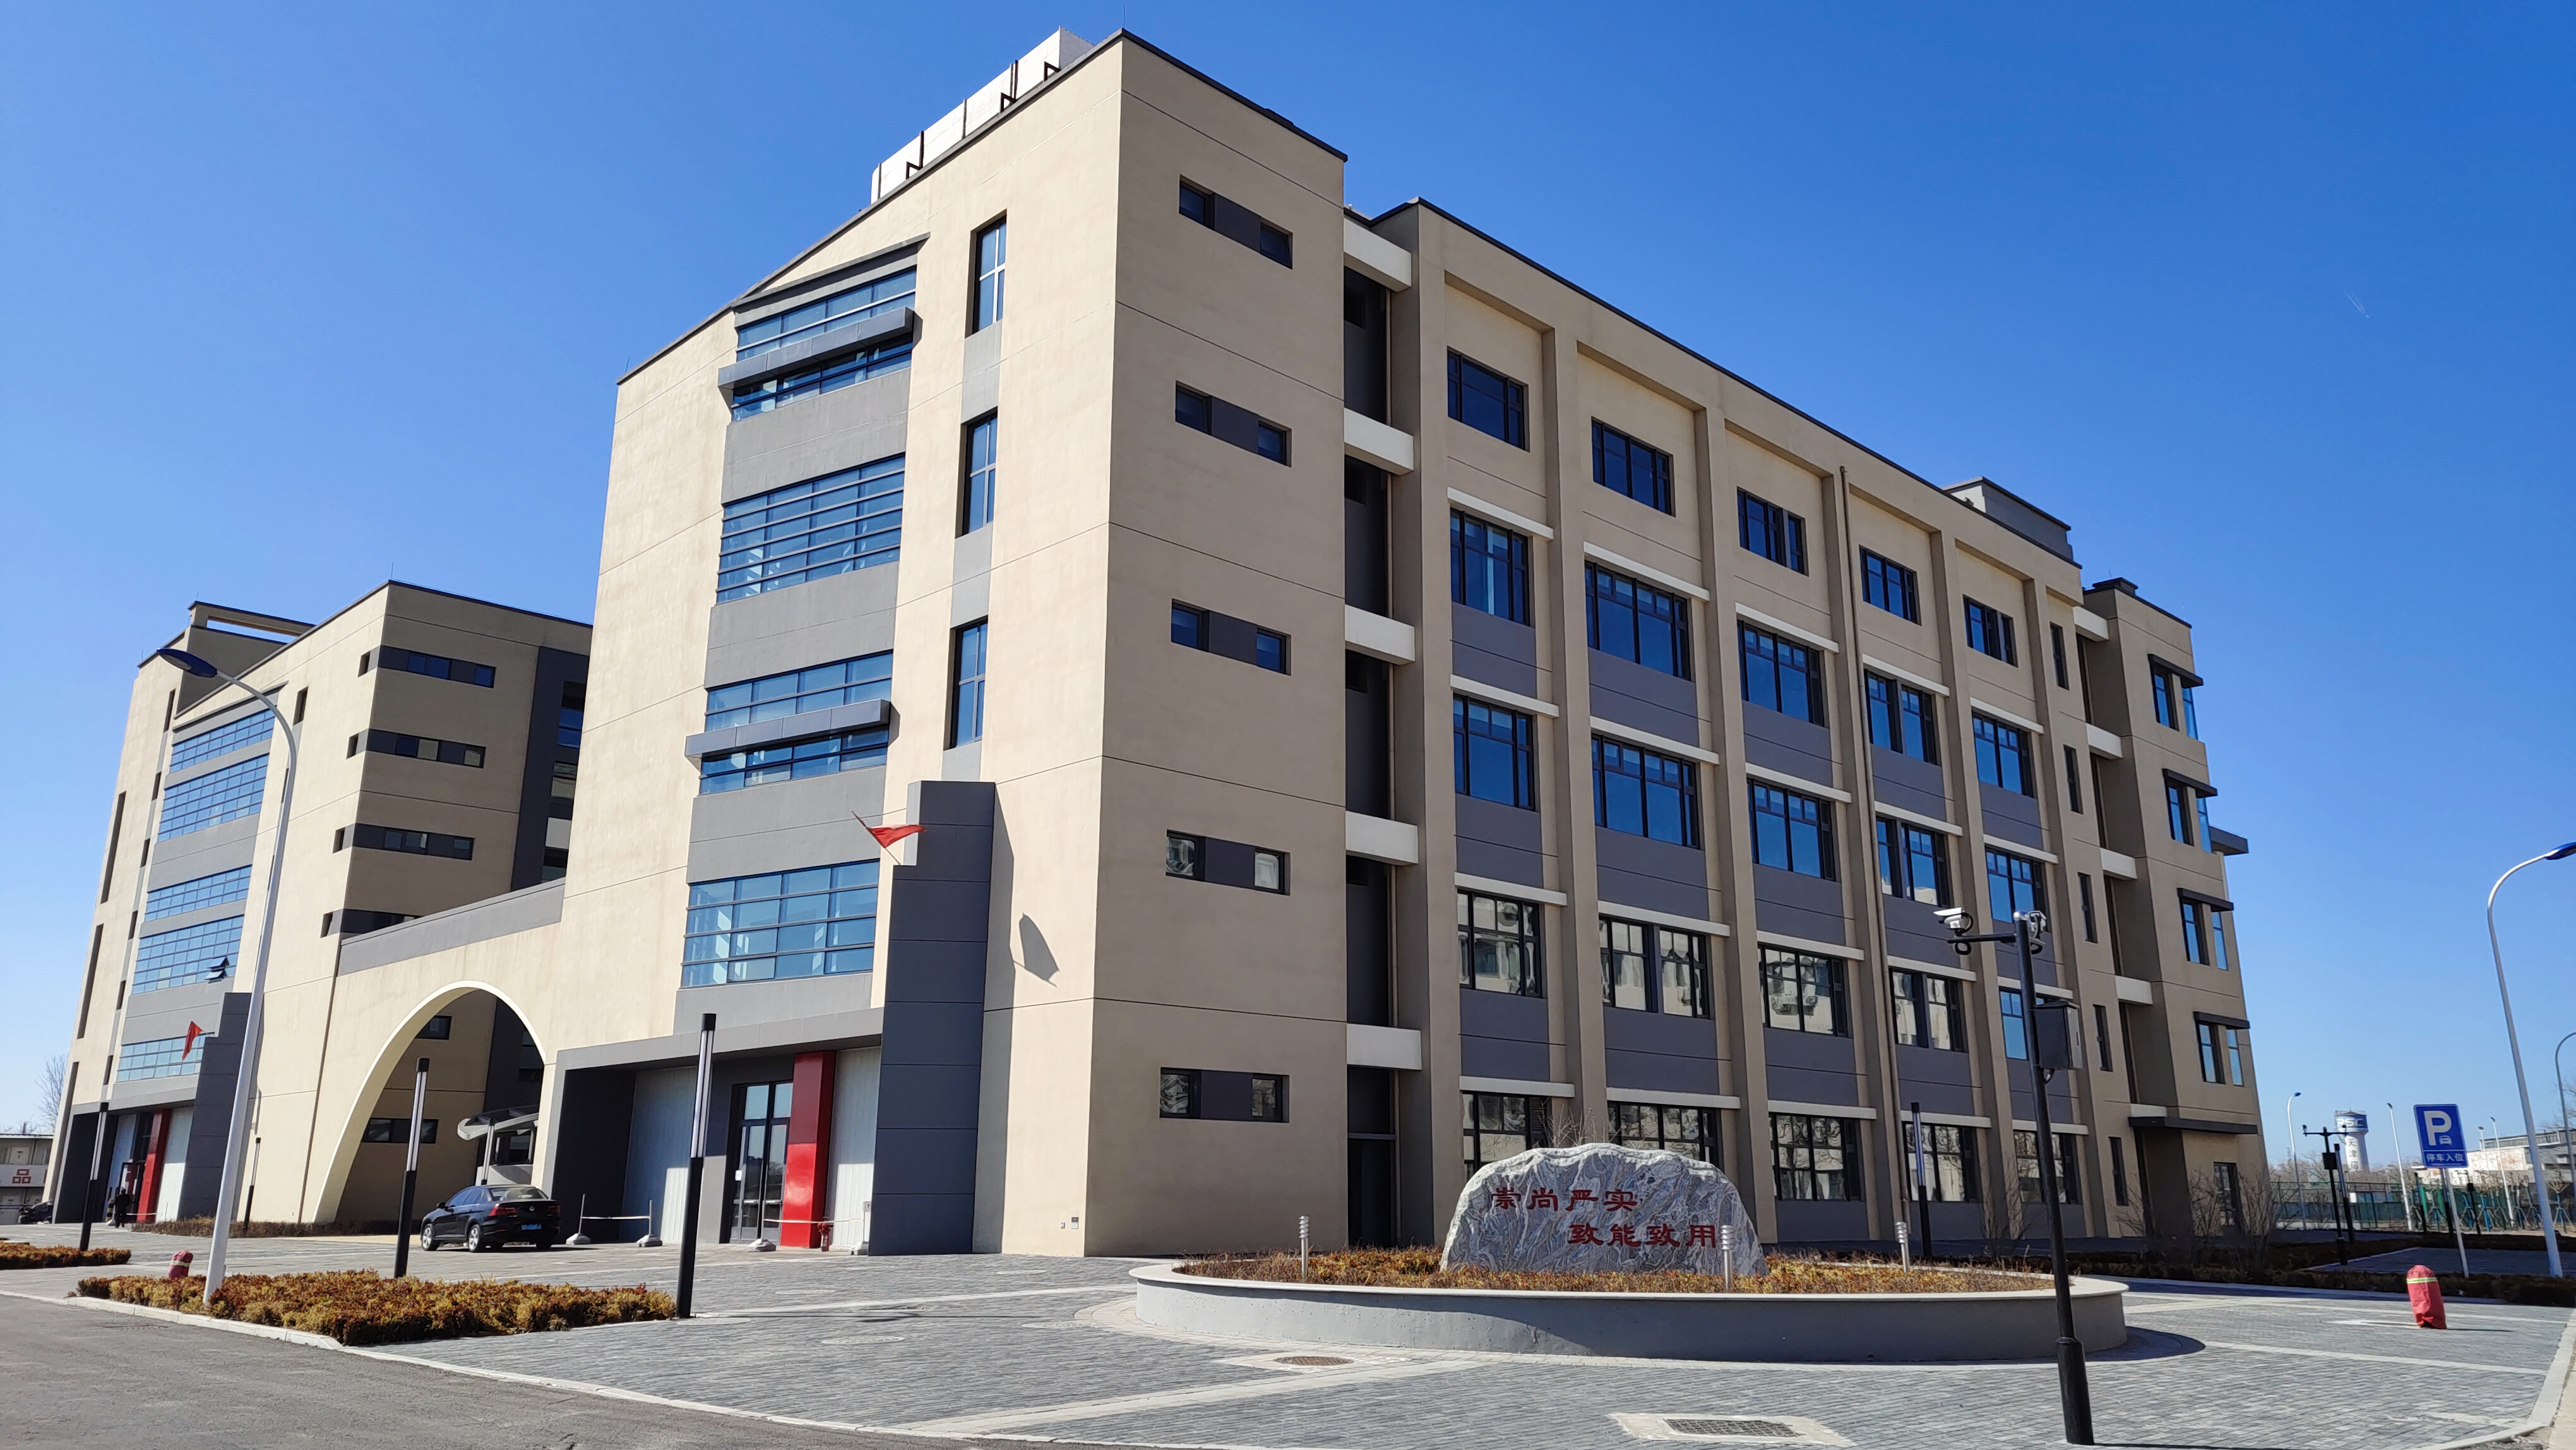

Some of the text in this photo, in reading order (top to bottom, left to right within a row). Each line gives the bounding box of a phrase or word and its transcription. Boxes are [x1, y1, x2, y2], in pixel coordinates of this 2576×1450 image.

[2423, 1110, 2452, 1146] P
[2426, 1153, 2464, 1162] 停车入位
[1490, 1187, 1638, 1212] 崇尚严实
[1567, 1224, 1717, 1249] 致能致用
